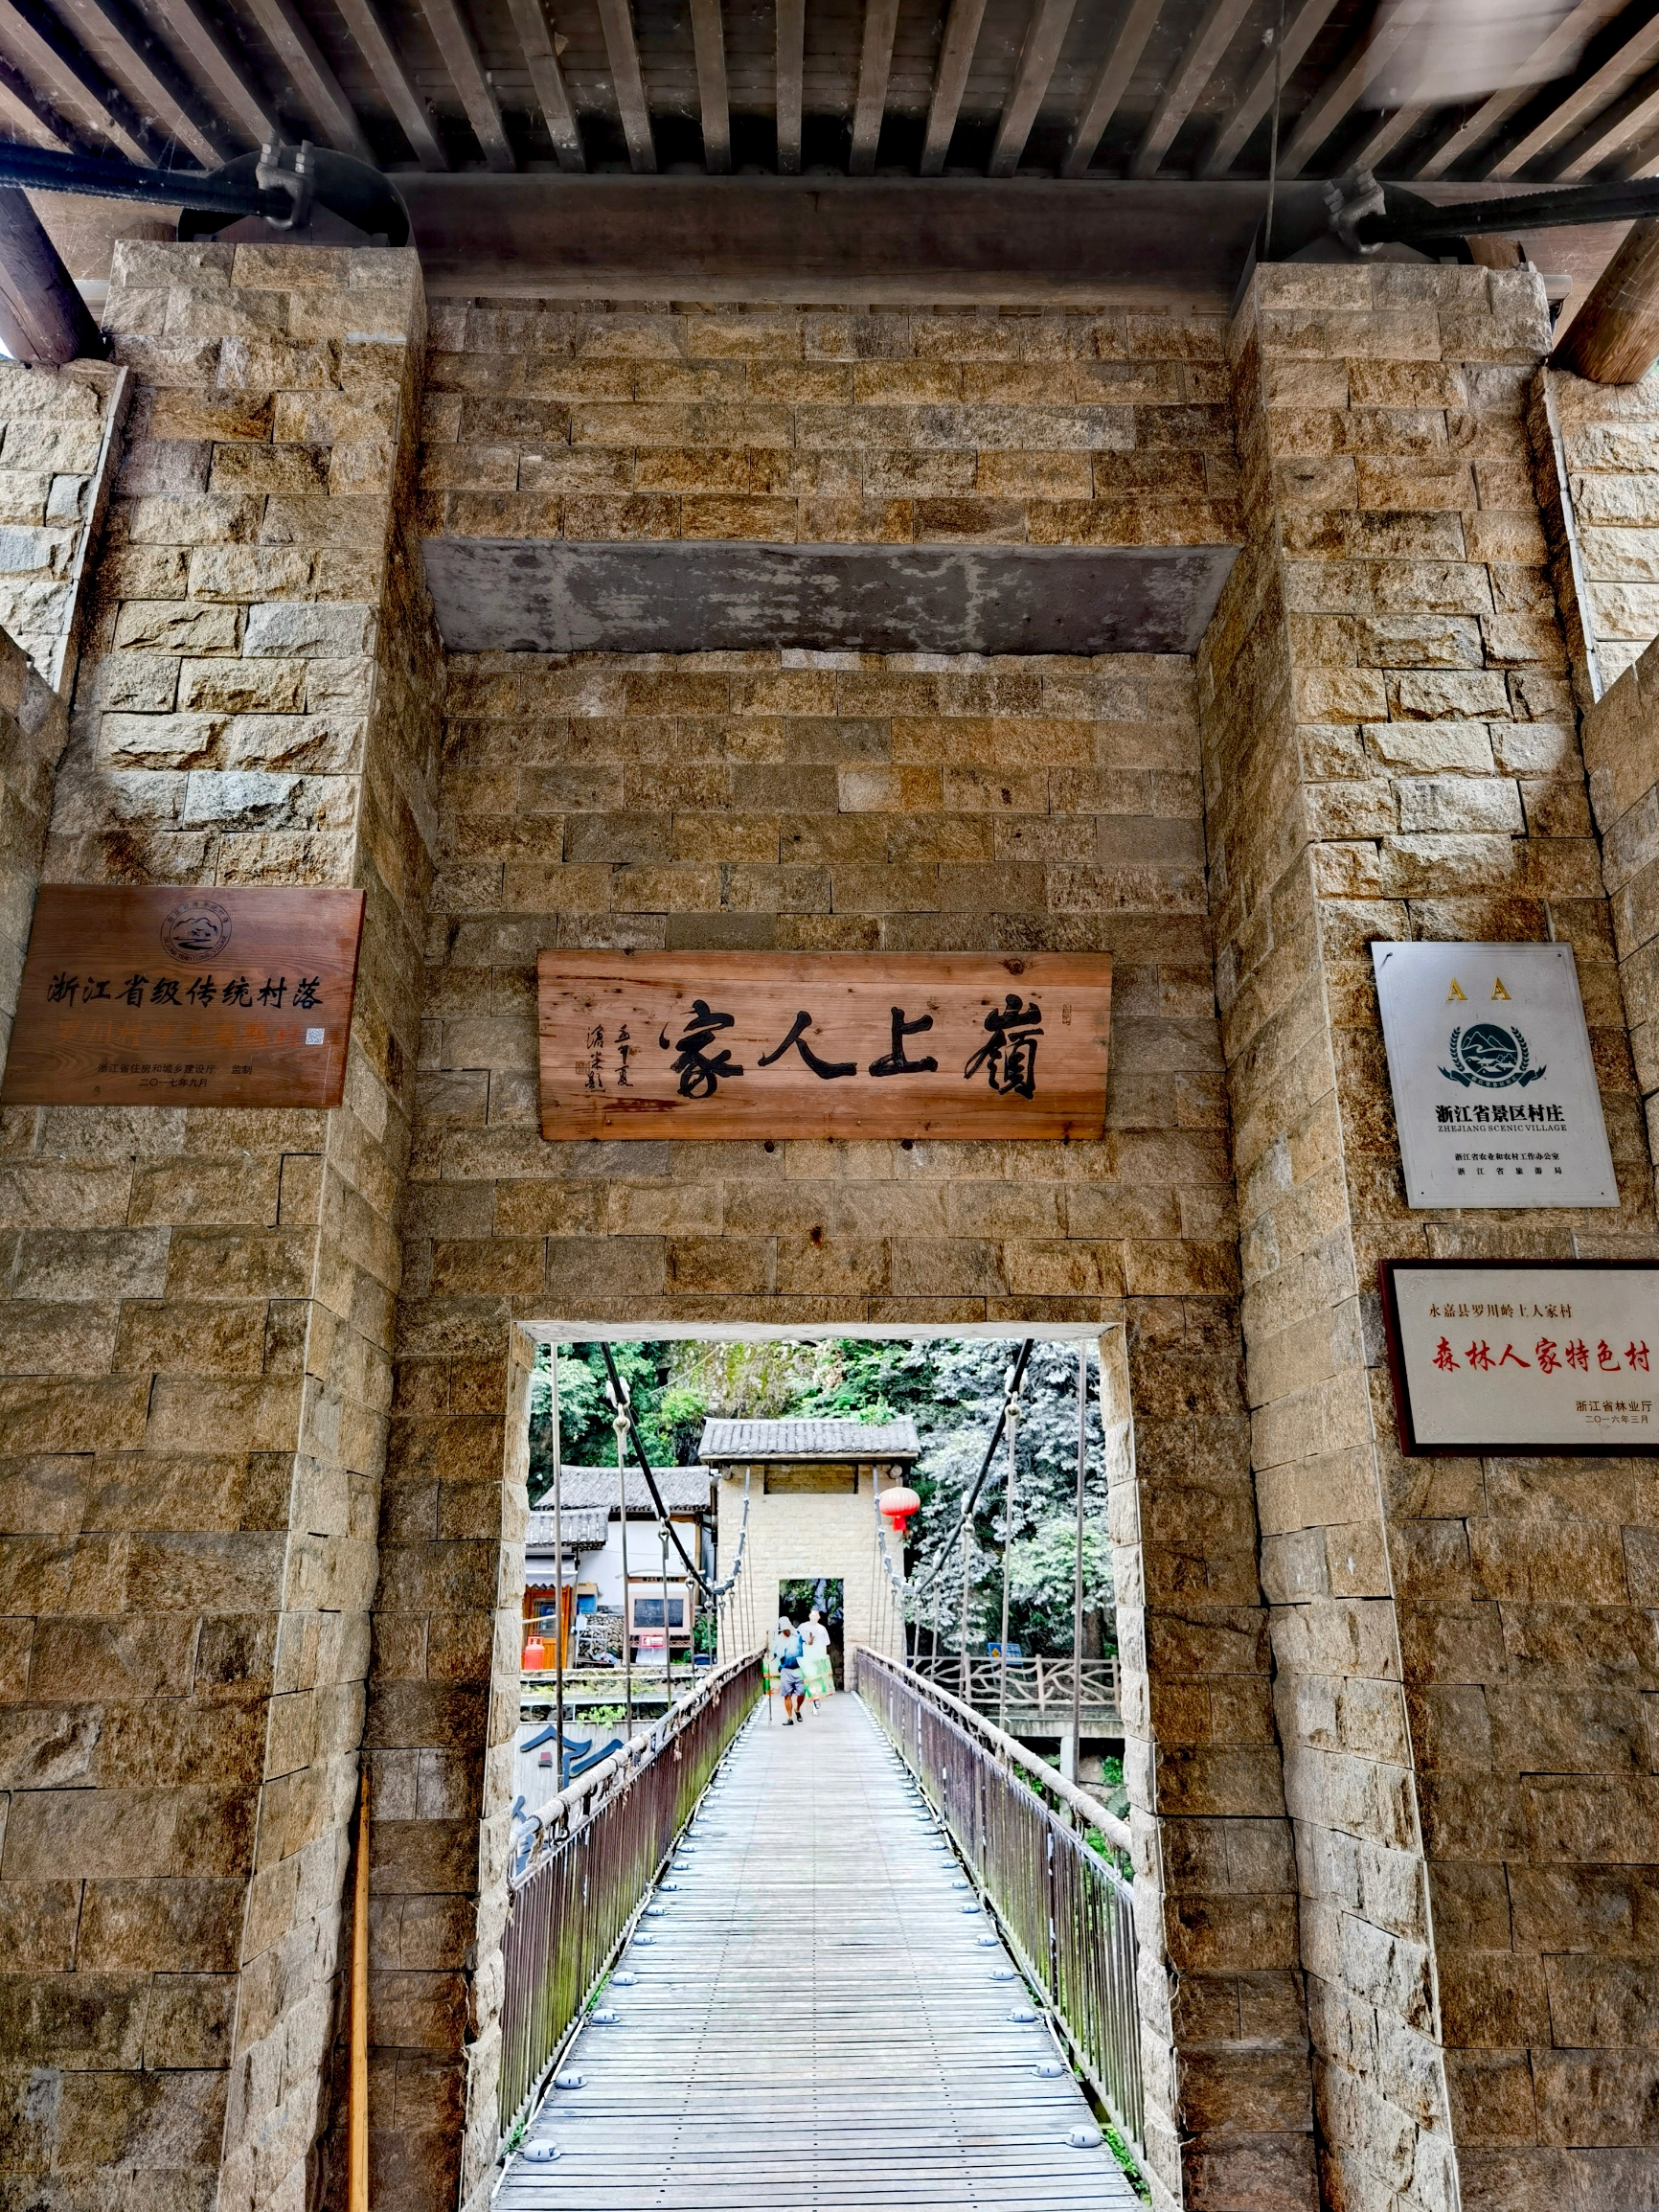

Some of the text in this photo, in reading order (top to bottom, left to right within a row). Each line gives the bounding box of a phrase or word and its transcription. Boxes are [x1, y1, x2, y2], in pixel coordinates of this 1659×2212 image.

[47, 971, 324, 1010] 浙江省级传统村落
[98, 1062, 253, 1075] 浙江省住房和城乡建设厅 监制
[1435, 1104, 1566, 1123] 浙江省景区村庄
[1454, 1152, 1560, 1161] 浙江省农业和农村工作办公室
[1457, 1167, 1562, 1175] 浙江省旅游局
[1428, 1303, 1573, 1318] 永嘉县罗川岭上人家村
[1432, 1335, 1650, 1375] 森林人家特色村
[1576, 1400, 1653, 1413] 浙江省林业厅
